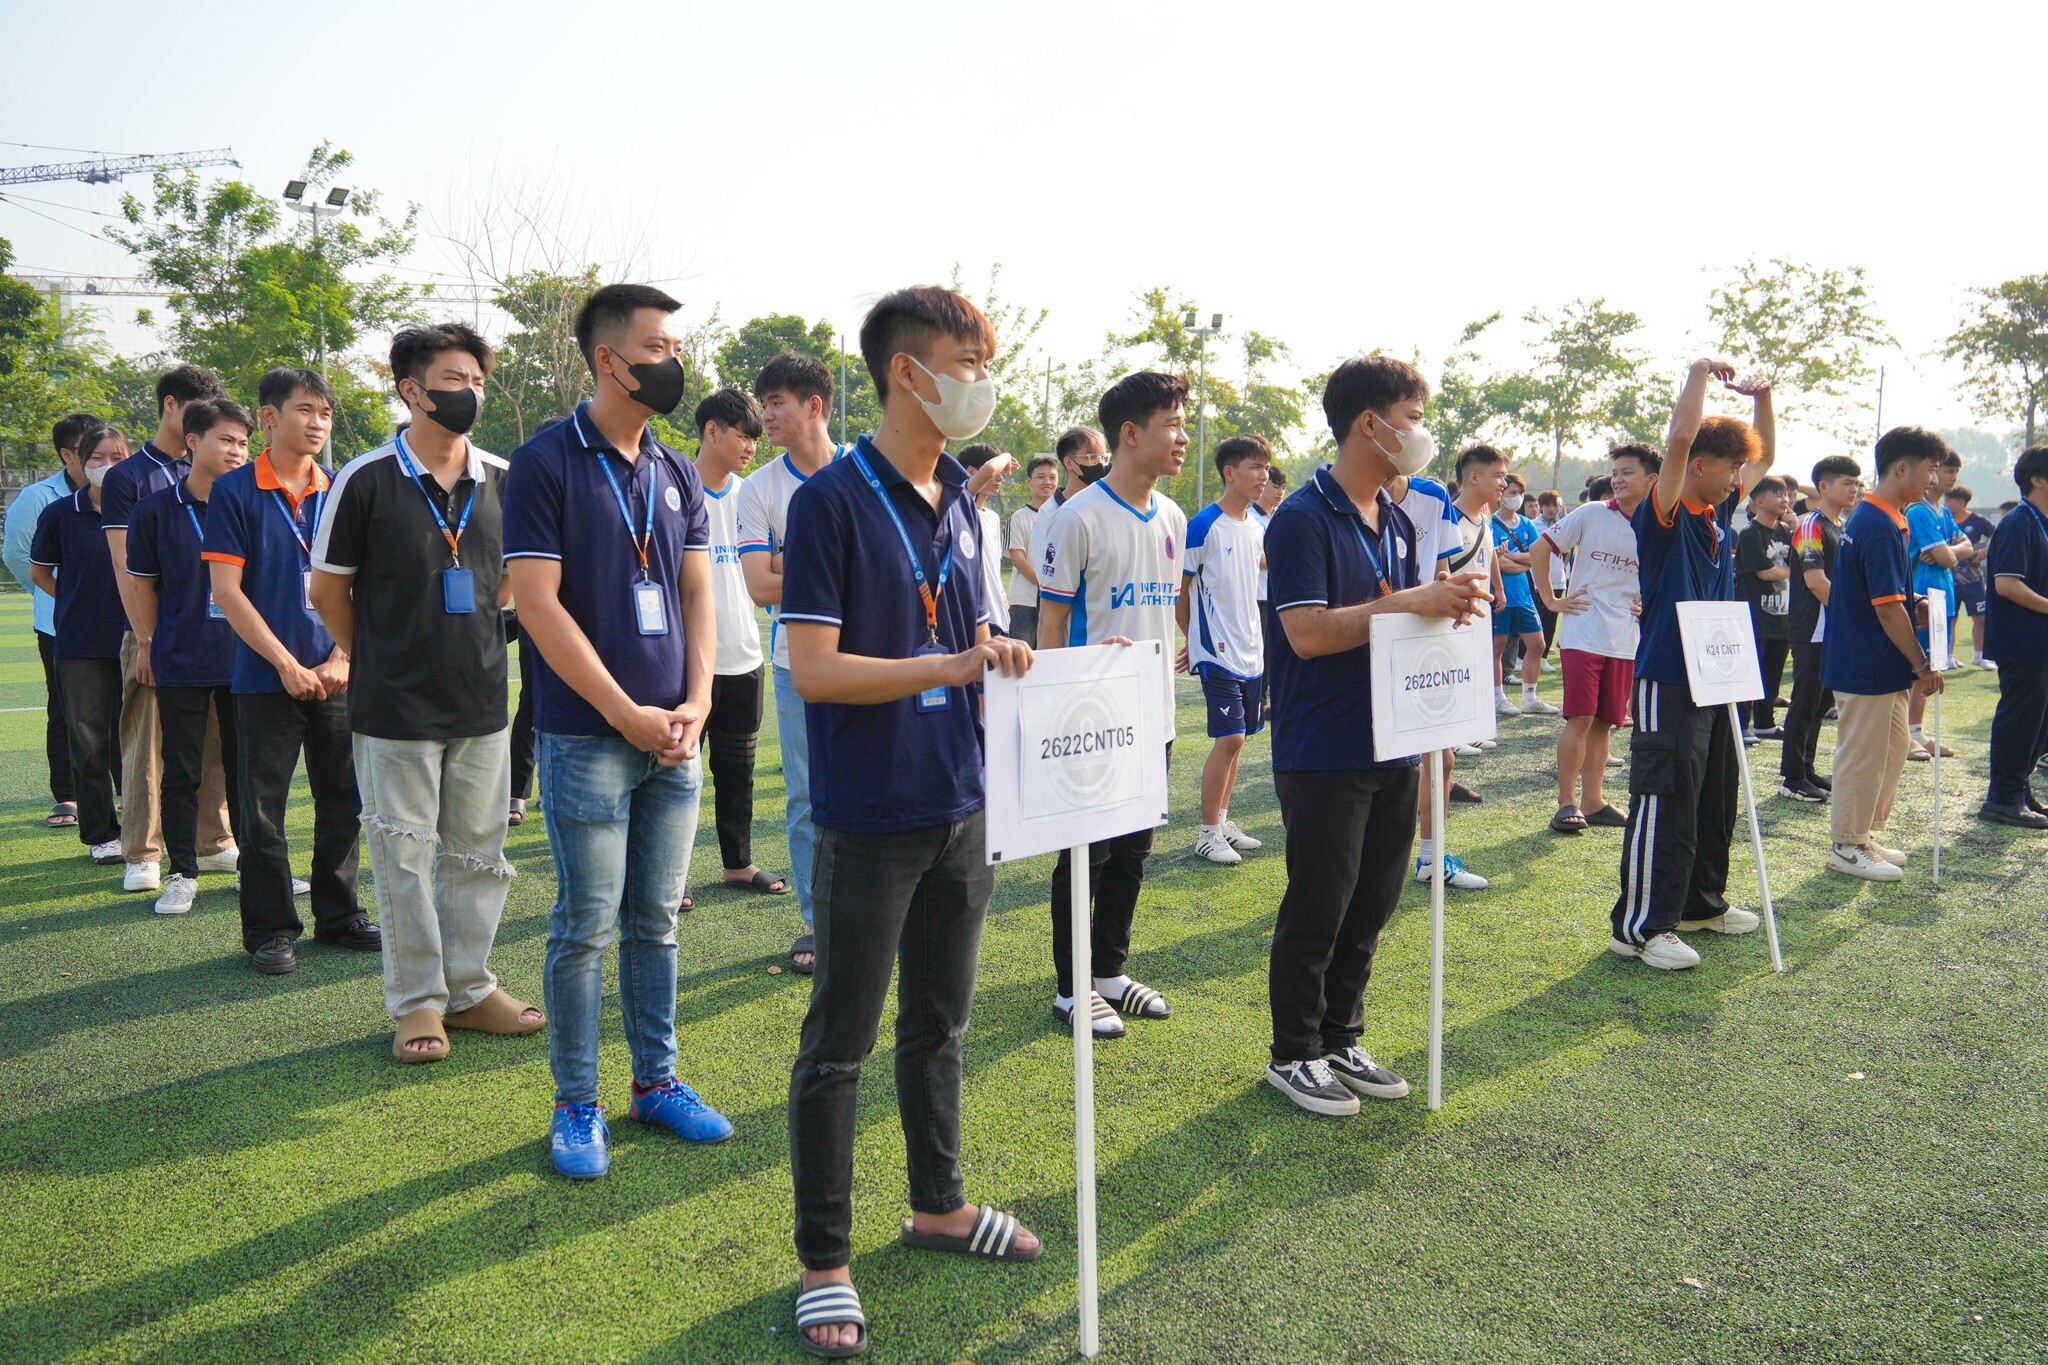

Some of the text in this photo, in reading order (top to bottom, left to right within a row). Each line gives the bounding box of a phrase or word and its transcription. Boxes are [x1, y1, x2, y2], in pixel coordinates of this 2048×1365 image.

[1477, 548, 1485, 567] 4
[1591, 551, 1639, 570] ETIHA
[1705, 644, 1741, 656] K24 CNTT
[1405, 668, 1471, 691] 2622CNT04
[1041, 726, 1134, 760] 2622CNT05
